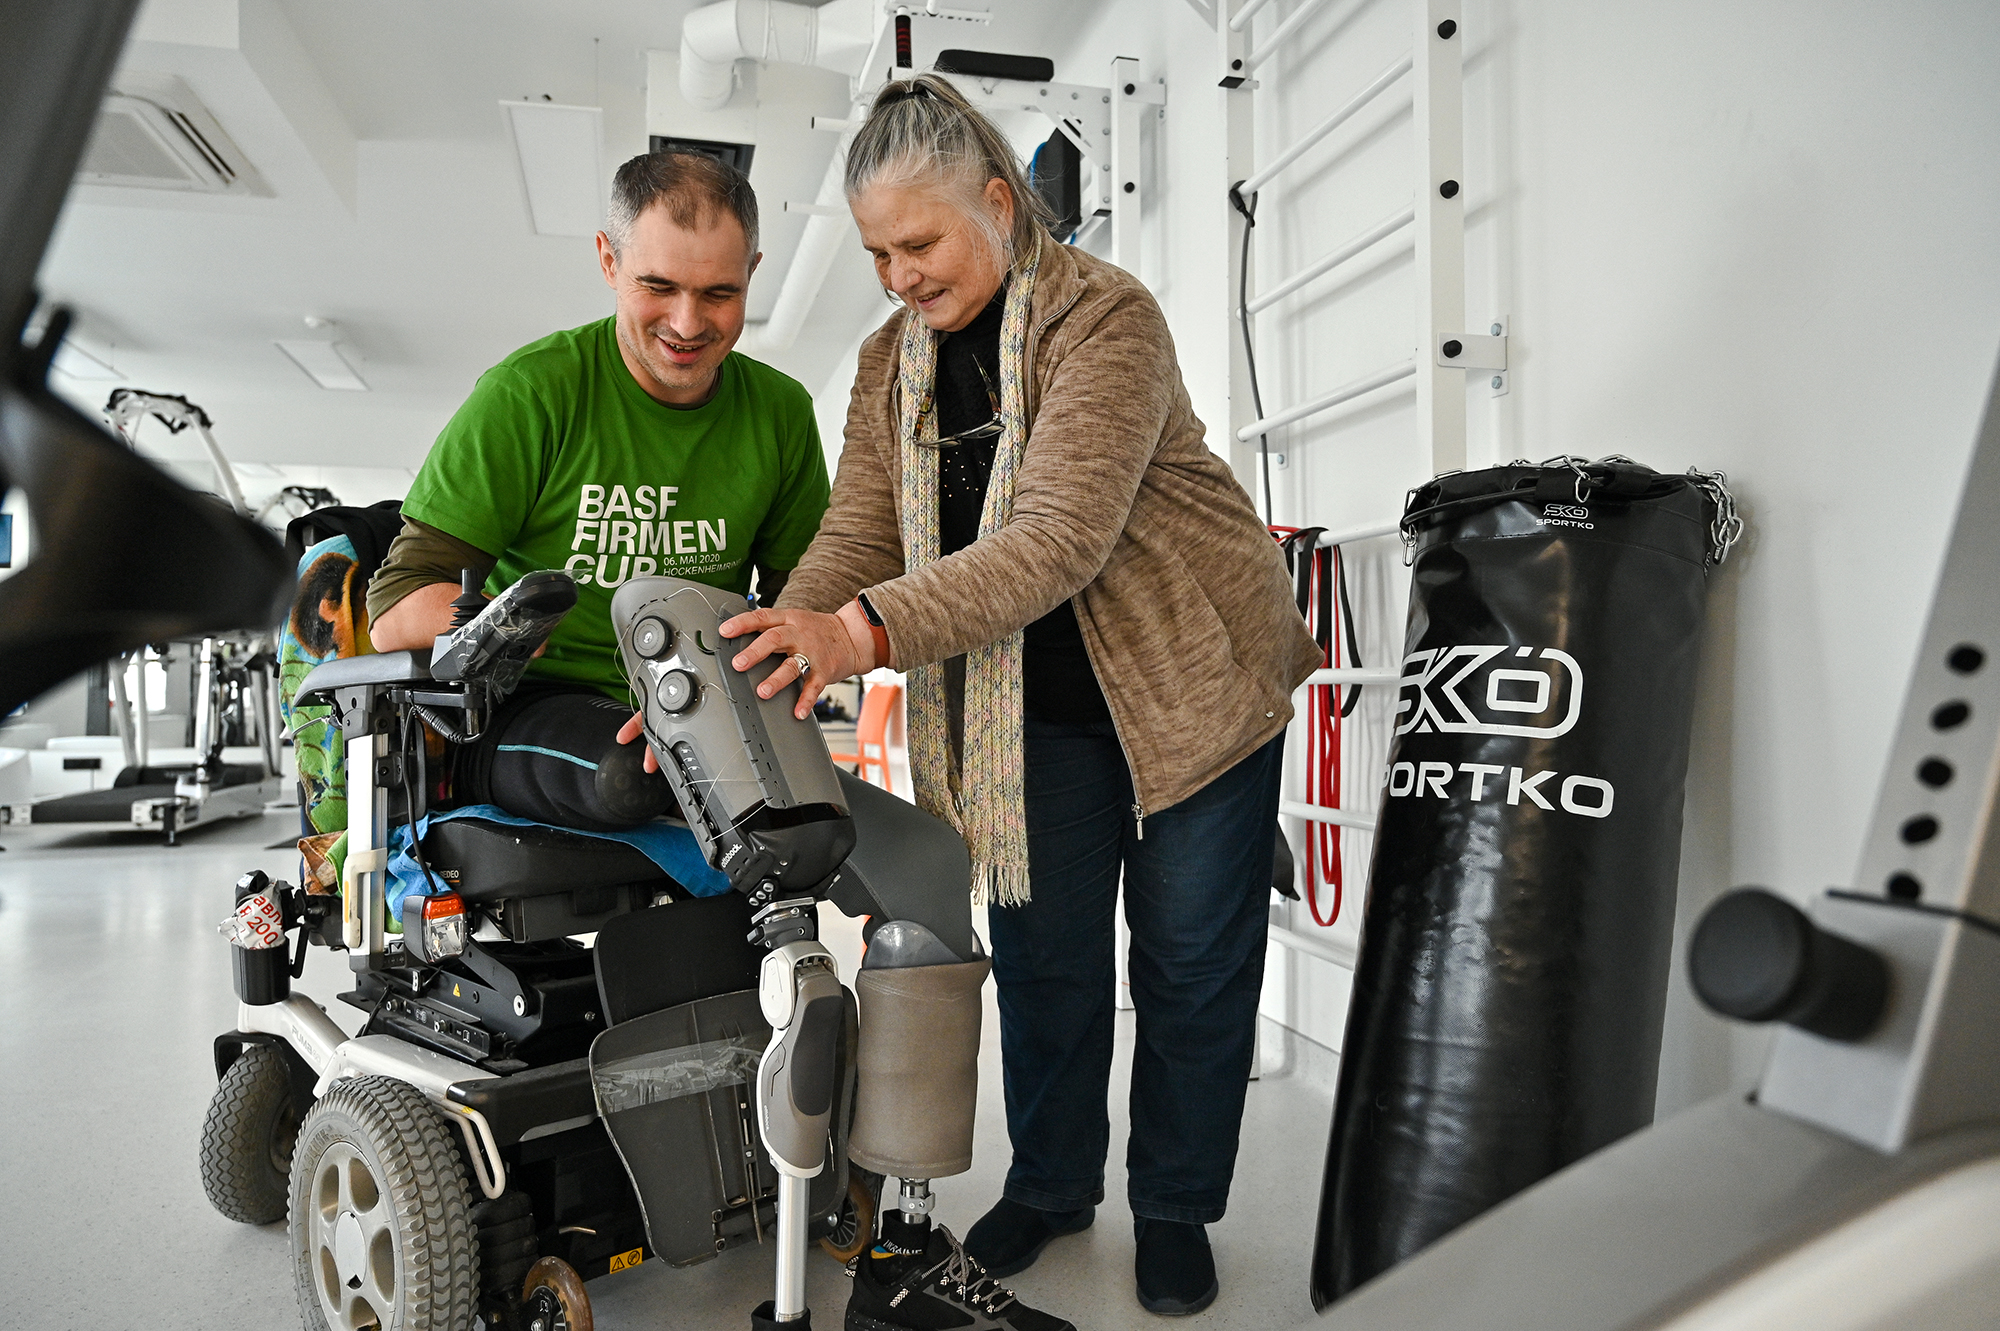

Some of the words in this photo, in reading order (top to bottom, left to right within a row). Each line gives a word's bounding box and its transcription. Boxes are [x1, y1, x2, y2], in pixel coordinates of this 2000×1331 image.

[578, 484, 679, 520] BASF
[570, 518, 727, 555] FIRMEN
[1535, 518, 1594, 530] SPORTKO
[564, 554, 658, 588] CUP
[663, 556, 678, 566] 06.
[680, 555, 698, 565] MAI
[699, 553, 721, 564] 2020
[246, 916, 279, 945] 200
